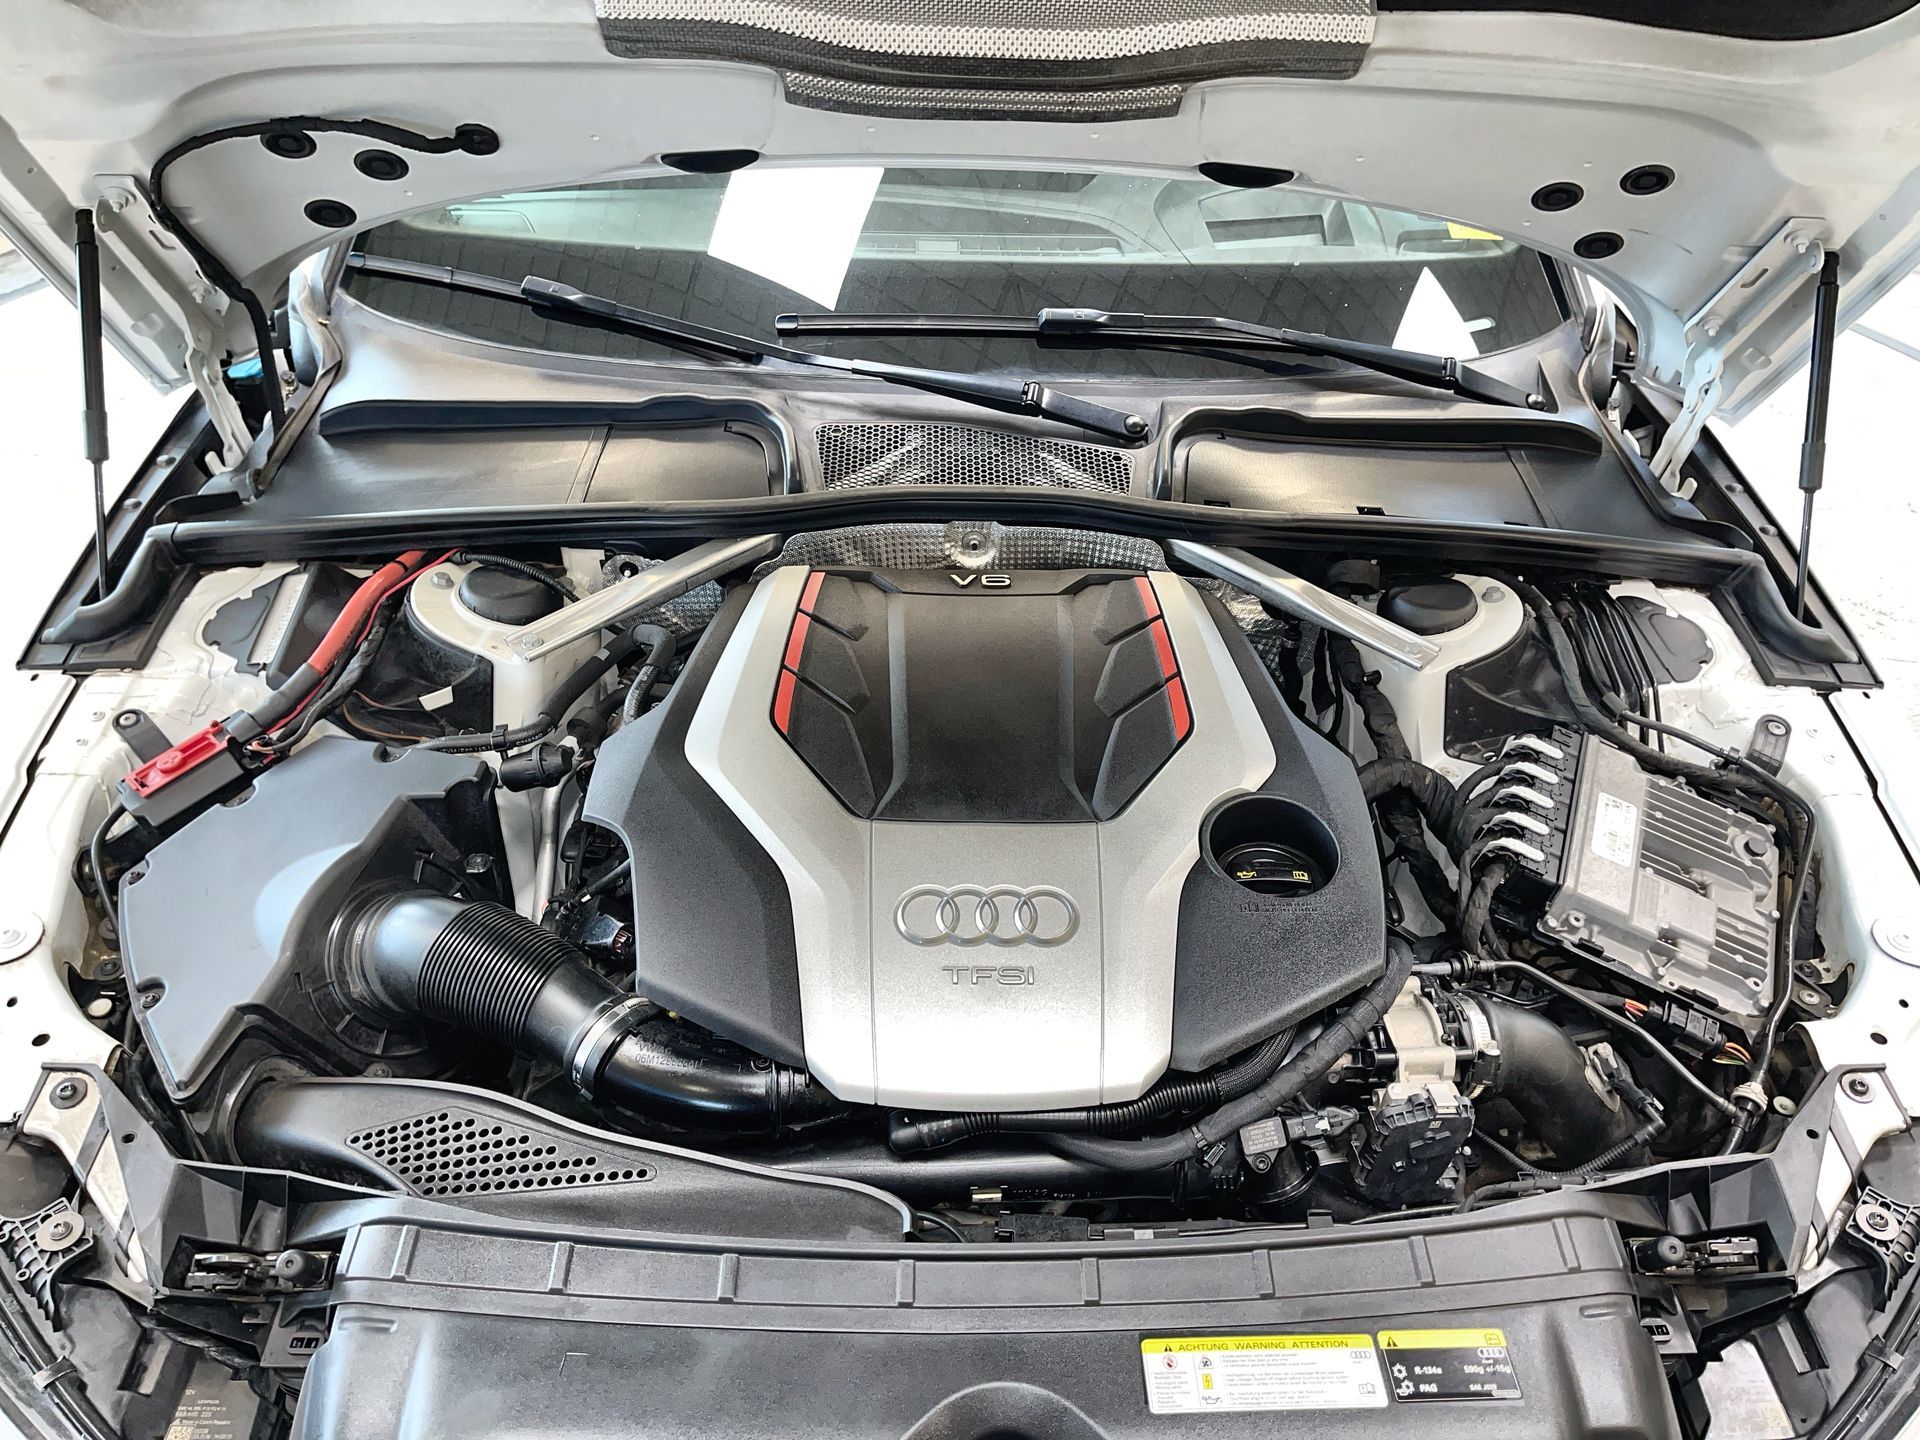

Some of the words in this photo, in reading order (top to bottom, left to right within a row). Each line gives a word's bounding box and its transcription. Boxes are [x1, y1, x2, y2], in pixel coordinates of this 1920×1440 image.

[949, 574, 1011, 588] V6
[942, 966, 1034, 985] TFSI
[1178, 1343, 1229, 1352] ACHTUNG
[1234, 1341, 1286, 1350] WARNING
[1292, 1340, 1349, 1349] ATTENTION
[1413, 1365, 1443, 1375] R-134a
[1419, 1383, 1438, 1393] PAG
